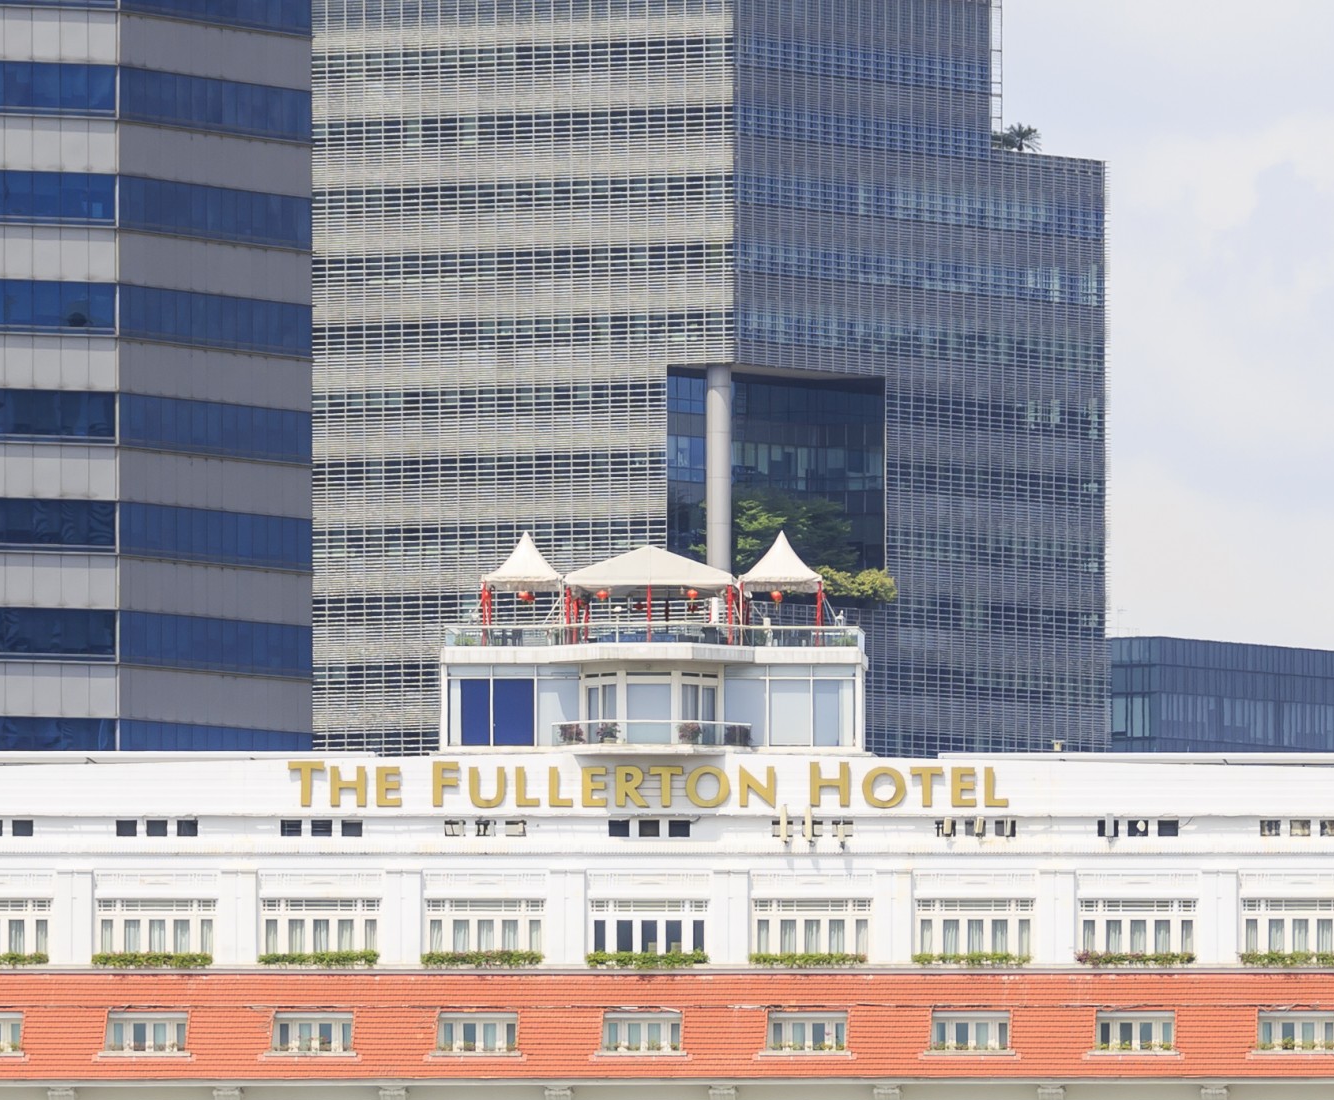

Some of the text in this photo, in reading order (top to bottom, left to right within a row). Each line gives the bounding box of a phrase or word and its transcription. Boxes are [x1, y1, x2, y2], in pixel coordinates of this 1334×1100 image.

[288, 760, 1009, 809] THE FULLERTON HOTEL
